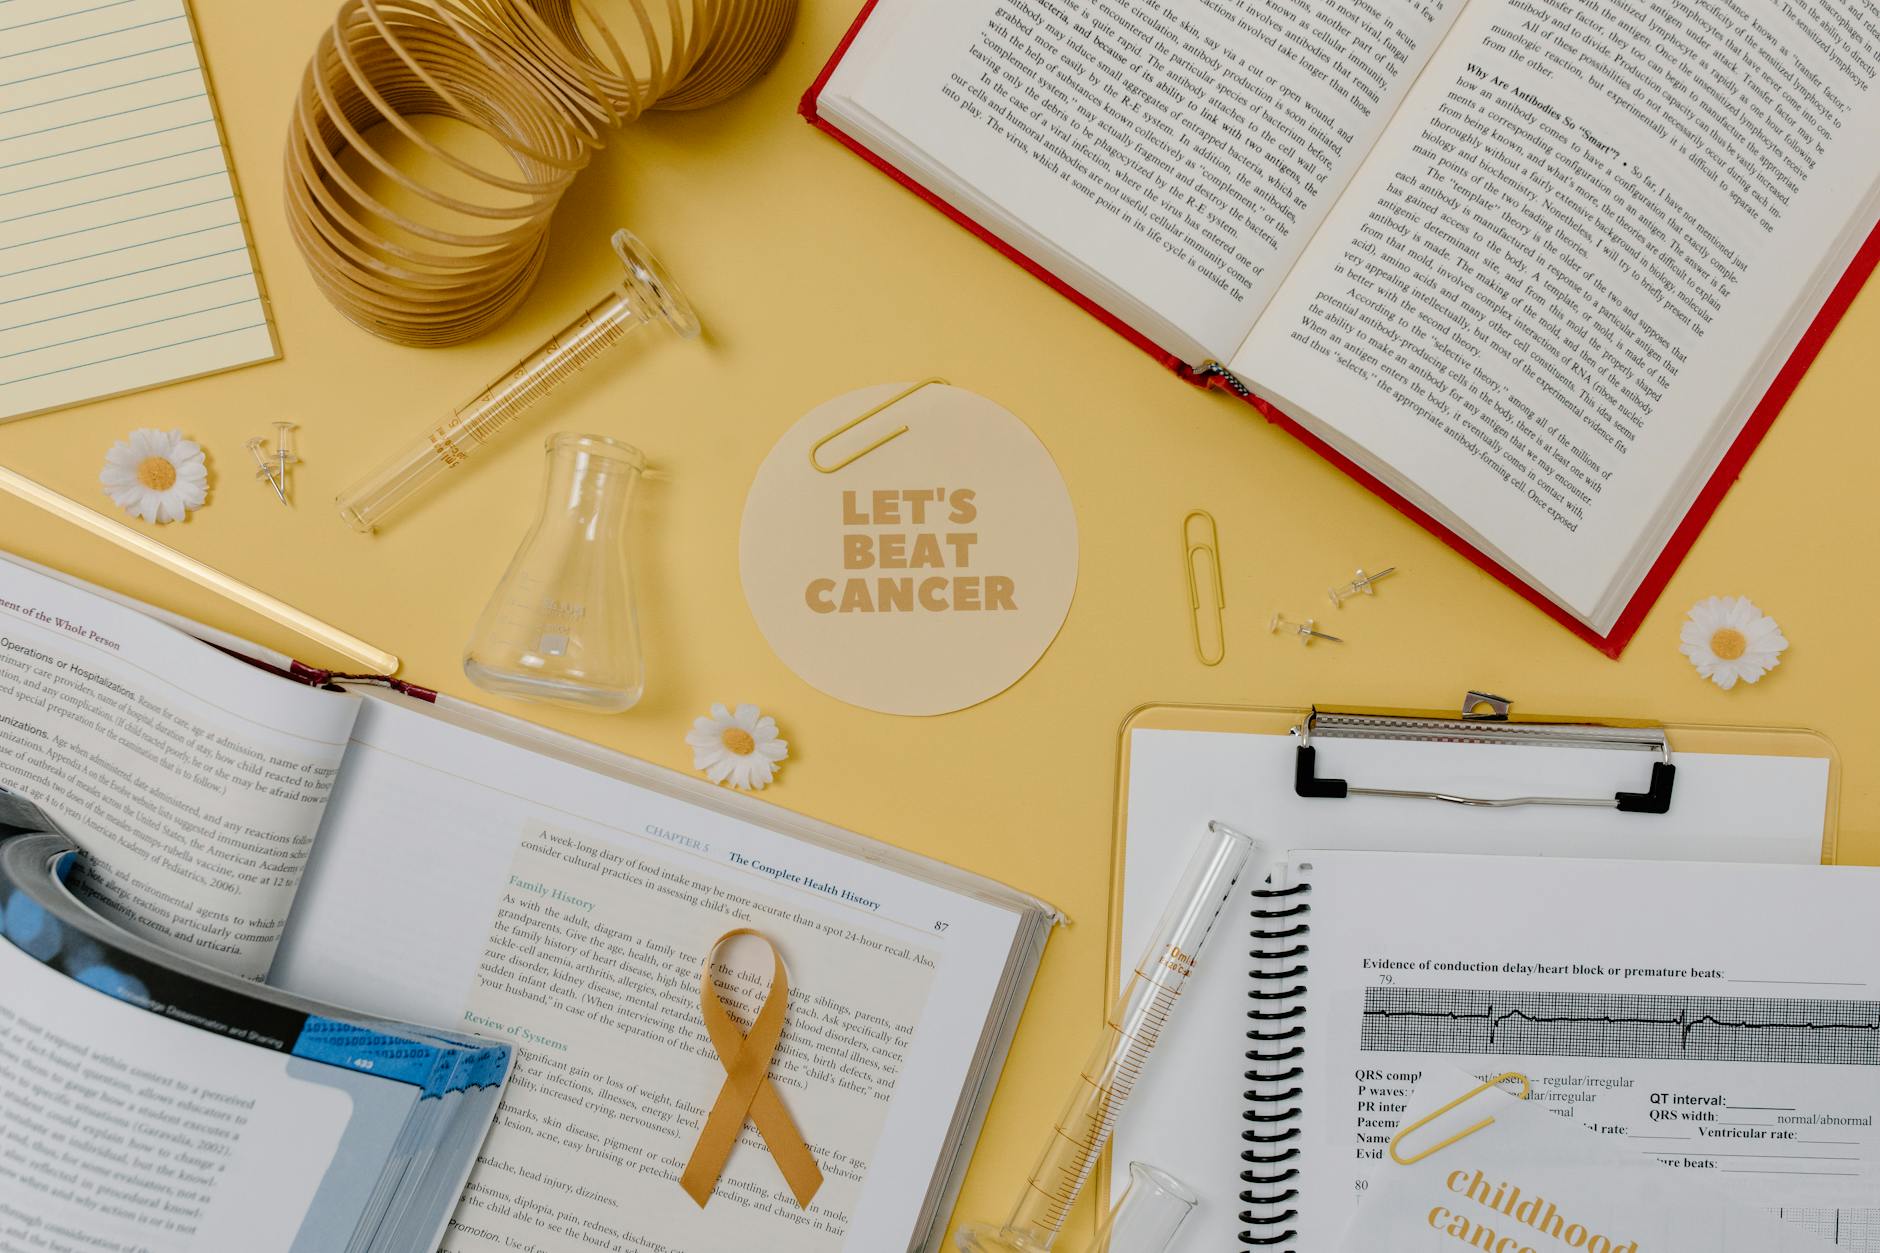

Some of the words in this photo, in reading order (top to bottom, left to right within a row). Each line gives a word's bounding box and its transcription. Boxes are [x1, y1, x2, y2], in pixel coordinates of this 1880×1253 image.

[1466, 62, 1488, 80] Why
[1490, 75, 1509, 90] Are
[1510, 87, 1561, 120] Antibodies
[1561, 116, 1576, 130] So
[1630, 165, 1643, 179] So
[1642, 175, 1656, 192] far,
[1658, 187, 1666, 197] I
[1664, 192, 1683, 214] have
[1682, 211, 1697, 226] not
[1695, 223, 1735, 259] mentioned
[1730, 257, 1748, 272] just
[941, 85, 960, 102] into
[959, 100, 982, 119] play.
[986, 115, 1004, 134] The
[1006, 131, 1028, 154] virus,
[1032, 150, 1059, 173] which
[1059, 171, 1071, 181] at
[1071, 178, 1096, 198] some
[1094, 196, 1121, 215] point
[1121, 211, 1132, 223] in
[1132, 218, 1146, 232] its
[1146, 227, 1162, 243] life
[1162, 241, 1187, 260] cycle
[1187, 255, 1196, 267] is
[1197, 264, 1229, 290] outside
[1229, 287, 1244, 302] the
[1346, 287, 1396, 322] According
[1397, 317, 1409, 328] to
[1410, 325, 1427, 339] the
[1507, 394, 1535, 420] among
[1535, 416, 1548, 428] all
[1547, 426, 1559, 436] of
[1557, 433, 1570, 448] the
[1570, 445, 1600, 472] millions
[1601, 470, 1613, 480] of
[1290, 331, 1311, 344] and
[1309, 340, 1331, 356] thus
[1376, 379, 1393, 393] the
[1392, 390, 1444, 428] appropriate
[1443, 425, 1511, 482] antibody-forming
[1510, 478, 1527, 493] cell.
[1527, 489, 1547, 509] Once
[1546, 506, 1578, 532] exposed
[842, 487, 978, 525] LET'S
[842, 532, 978, 570] BEAT
[804, 575, 1019, 614] CANCER
[22, 607, 37, 616] of
[34, 610, 52, 624] the
[55, 616, 87, 636] Whole
[88, 630, 120, 651] Person
[0, 637, 54, 665] Operations
[56, 660, 68, 669] or
[69, 663, 136, 701] Hospitalizations.
[521, 840, 562, 859] consider
[563, 854, 601, 872] cultural
[600, 866, 643, 885] practices
[645, 878, 655, 890] in
[656, 885, 698, 906] assessing
[538, 830, 547, 840] A
[550, 834, 598, 858] week-long
[599, 848, 624, 866] diary
[625, 858, 638, 868] of
[637, 860, 660, 876] food
[661, 868, 690, 886] intake
[690, 881, 712, 895] may
[712, 885, 725, 898] be
[726, 892, 751, 906] more
[752, 902, 791, 920] accurate
[792, 913, 814, 927] than
[822, 925, 843, 937] spot
[844, 930, 883, 950] 24-hour
[644, 824, 701, 850] CHAPTER
[702, 843, 710, 852] 5
[729, 851, 749, 866] The
[751, 860, 801, 883] Complete
[803, 876, 838, 896] Health
[840, 889, 880, 911] History
[934, 920, 949, 932] 87
[508, 874, 549, 898] Family
[551, 888, 596, 912] History
[1363, 958, 1416, 969] Evidence
[1418, 958, 1432, 970] of
[1433, 961, 1498, 972] conduction
[1502, 962, 1568, 976] delay/heart
[1572, 964, 1604, 975] block
[1608, 967, 1621, 975] or
[1624, 968, 1686, 978] premature
[1691, 967, 1724, 978] beats:
[1379, 974, 1395, 985] 79.
[463, 1010, 504, 1031] Review
[506, 1025, 522, 1036] of
[521, 1028, 568, 1052] Systems
[1355, 1070, 1383, 1082] QRS
[1358, 1085, 1366, 1095] P
[1370, 1088, 1407, 1096] waves:
[1543, 1074, 1634, 1088] regular/irregular
[1358, 1101, 1375, 1112] PR
[1379, 1101, 1407, 1112] inter
[1649, 1109, 1678, 1120] QRS
[1681, 1110, 1718, 1122] width:
[1650, 1092, 1669, 1104] QT
[1673, 1093, 1726, 1106] interval:
[1357, 1132, 1390, 1144] Name
[1601, 1125, 1628, 1135] rate:
[1698, 1126, 1767, 1139] Ventricular
[1770, 1130, 1797, 1140] rate:
[1777, 1113, 1872, 1126] normal/abnormal
[1356, 1148, 1383, 1159] Evid
[1683, 1157, 1717, 1168] beats:
[1427, 1206, 1537, 1253] canc
